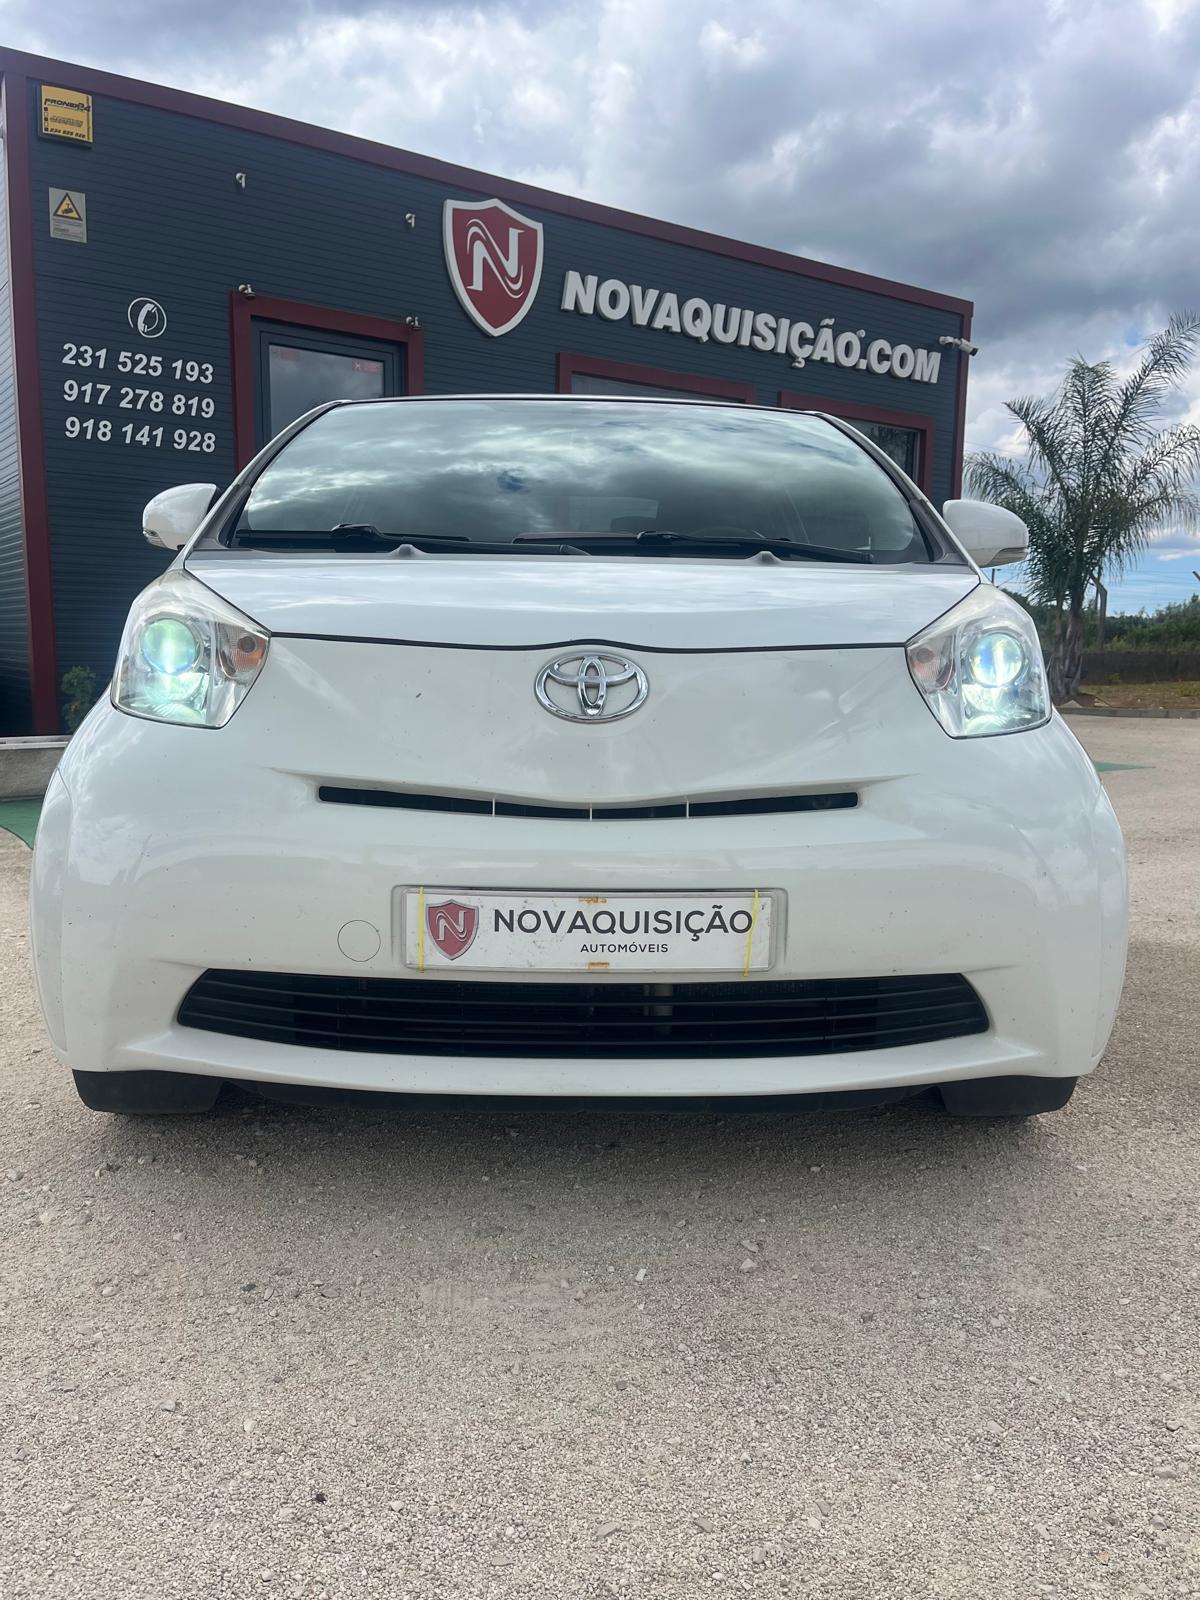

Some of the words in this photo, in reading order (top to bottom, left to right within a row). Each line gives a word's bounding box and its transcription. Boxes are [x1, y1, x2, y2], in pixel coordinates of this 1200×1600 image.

[560, 269, 942, 384] NOVAQUISIÇÃO.COM
[62, 342, 107, 369] 231
[117, 351, 163, 377] 525
[171, 359, 214, 384] 193
[63, 379, 111, 405] 917
[119, 387, 164, 412] 278
[172, 394, 215, 418] 819
[65, 416, 112, 442] 918
[121, 423, 164, 447] 141
[173, 429, 216, 453] 928
[493, 904, 753, 942] NOVAQUISIÇÃO
[580, 941, 669, 953] AUTOMÓVEIS
